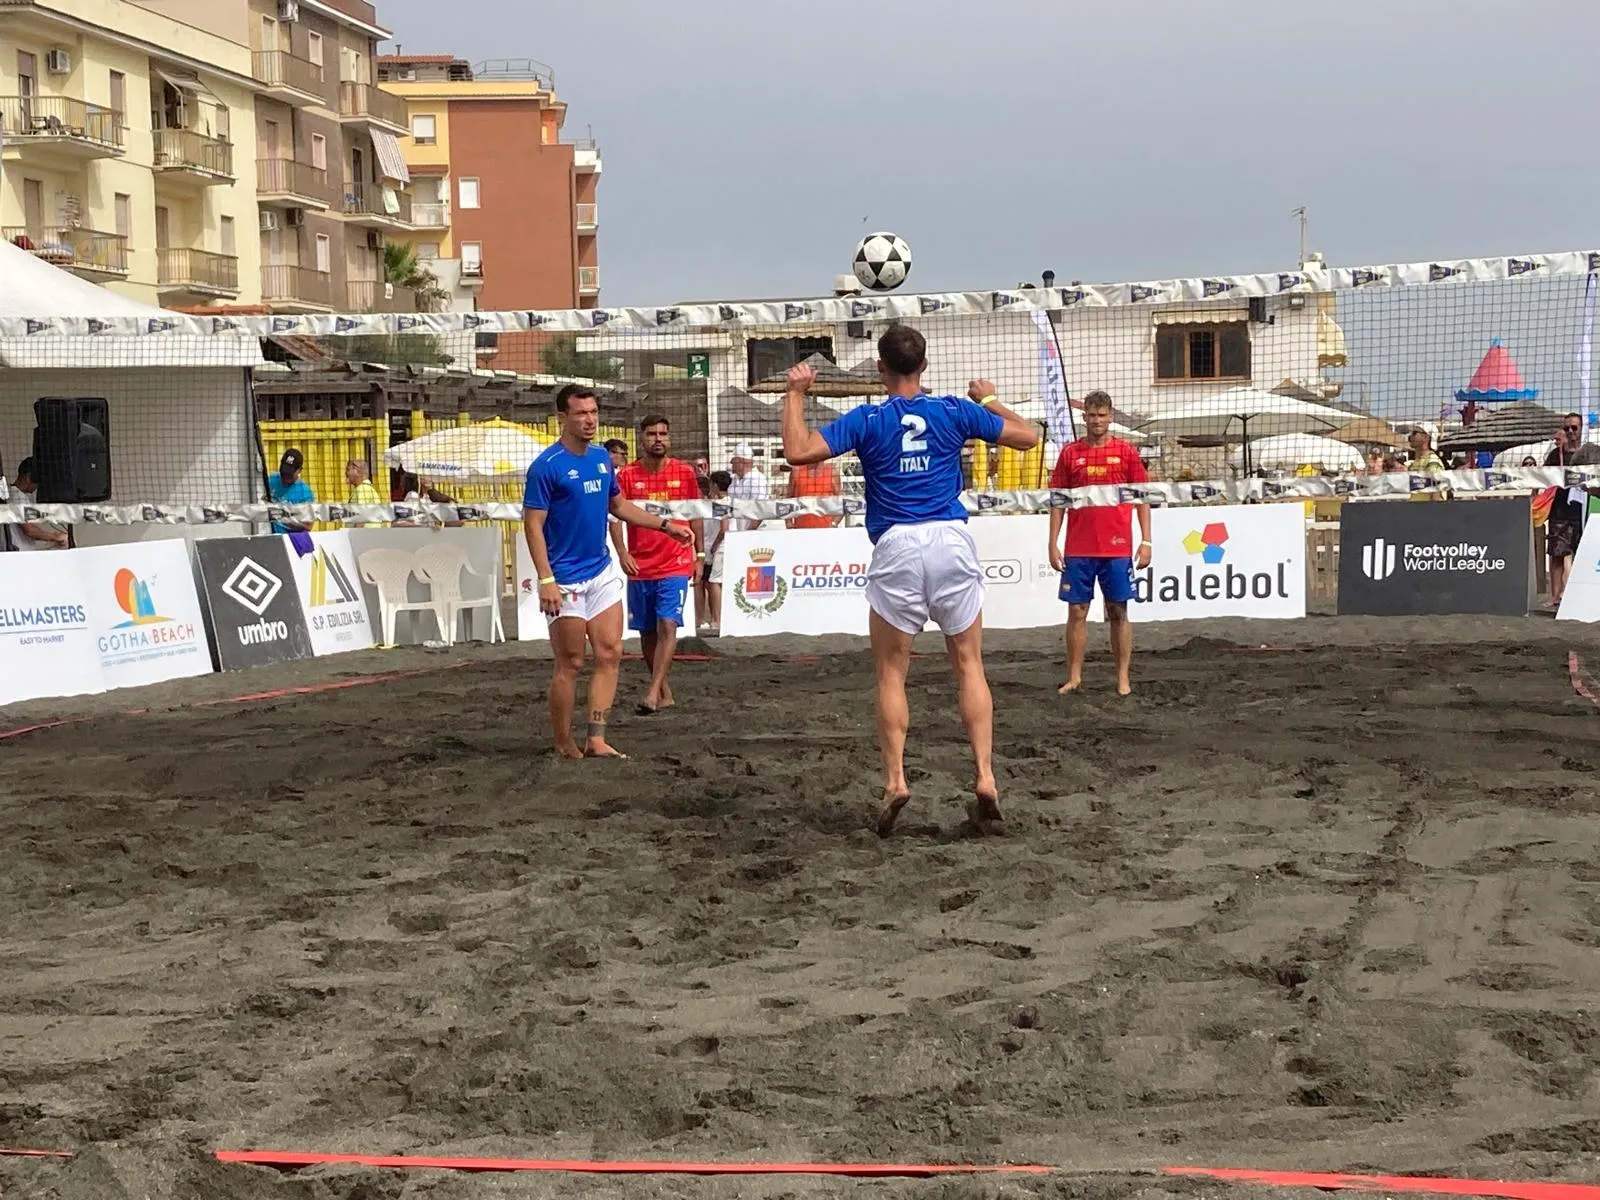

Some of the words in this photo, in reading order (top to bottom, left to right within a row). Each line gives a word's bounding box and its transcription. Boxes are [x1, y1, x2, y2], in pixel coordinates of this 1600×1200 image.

[900, 414, 928, 453] 2
[900, 455, 931, 473] ITALY
[583, 479, 602, 494] ITALY
[1404, 543, 1488, 559] Footvolley
[792, 561, 844, 576] CITTÀ
[848, 563, 867, 575] DI
[981, 564, 1015, 579] CO
[1404, 557, 1448, 571] World
[1449, 557, 1506, 575] League
[791, 576, 869, 589] LADISPO
[1134, 562, 1288, 602] dalebol
[328, 613, 353, 629] EDILIZIA
[353, 610, 366, 625] SRL
[98, 631, 149, 653] GOTHA
[153, 623, 196, 645] BEACH
[238, 617, 288, 645] umbro
